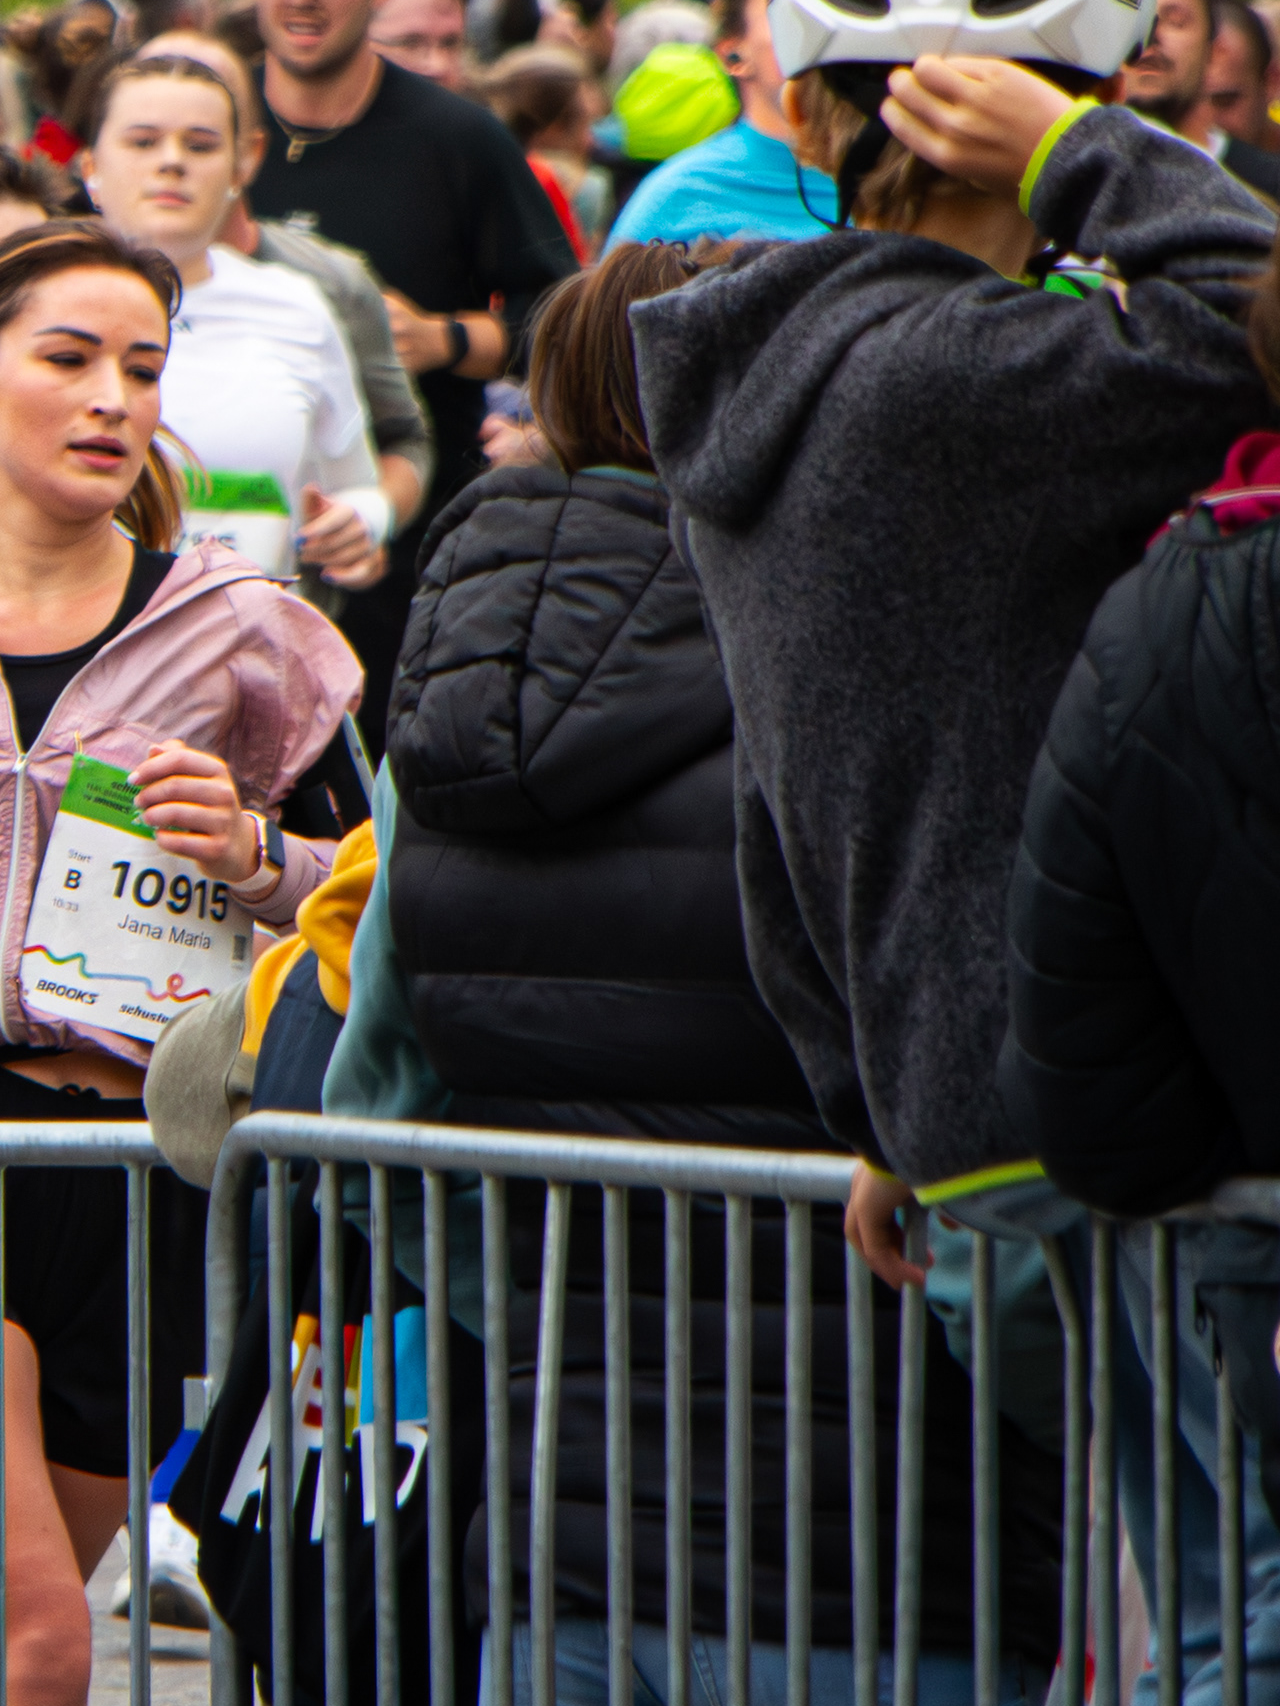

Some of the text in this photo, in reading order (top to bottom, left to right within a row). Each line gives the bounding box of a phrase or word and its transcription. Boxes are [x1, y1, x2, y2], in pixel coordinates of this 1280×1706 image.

[68, 848, 93, 864] Start
[64, 868, 82, 891] B
[111, 860, 229, 923] 10915
[117, 913, 212, 951] Jana Maria
[35, 978, 99, 1006] BROOKS
[119, 1002, 171, 1025] schuste
